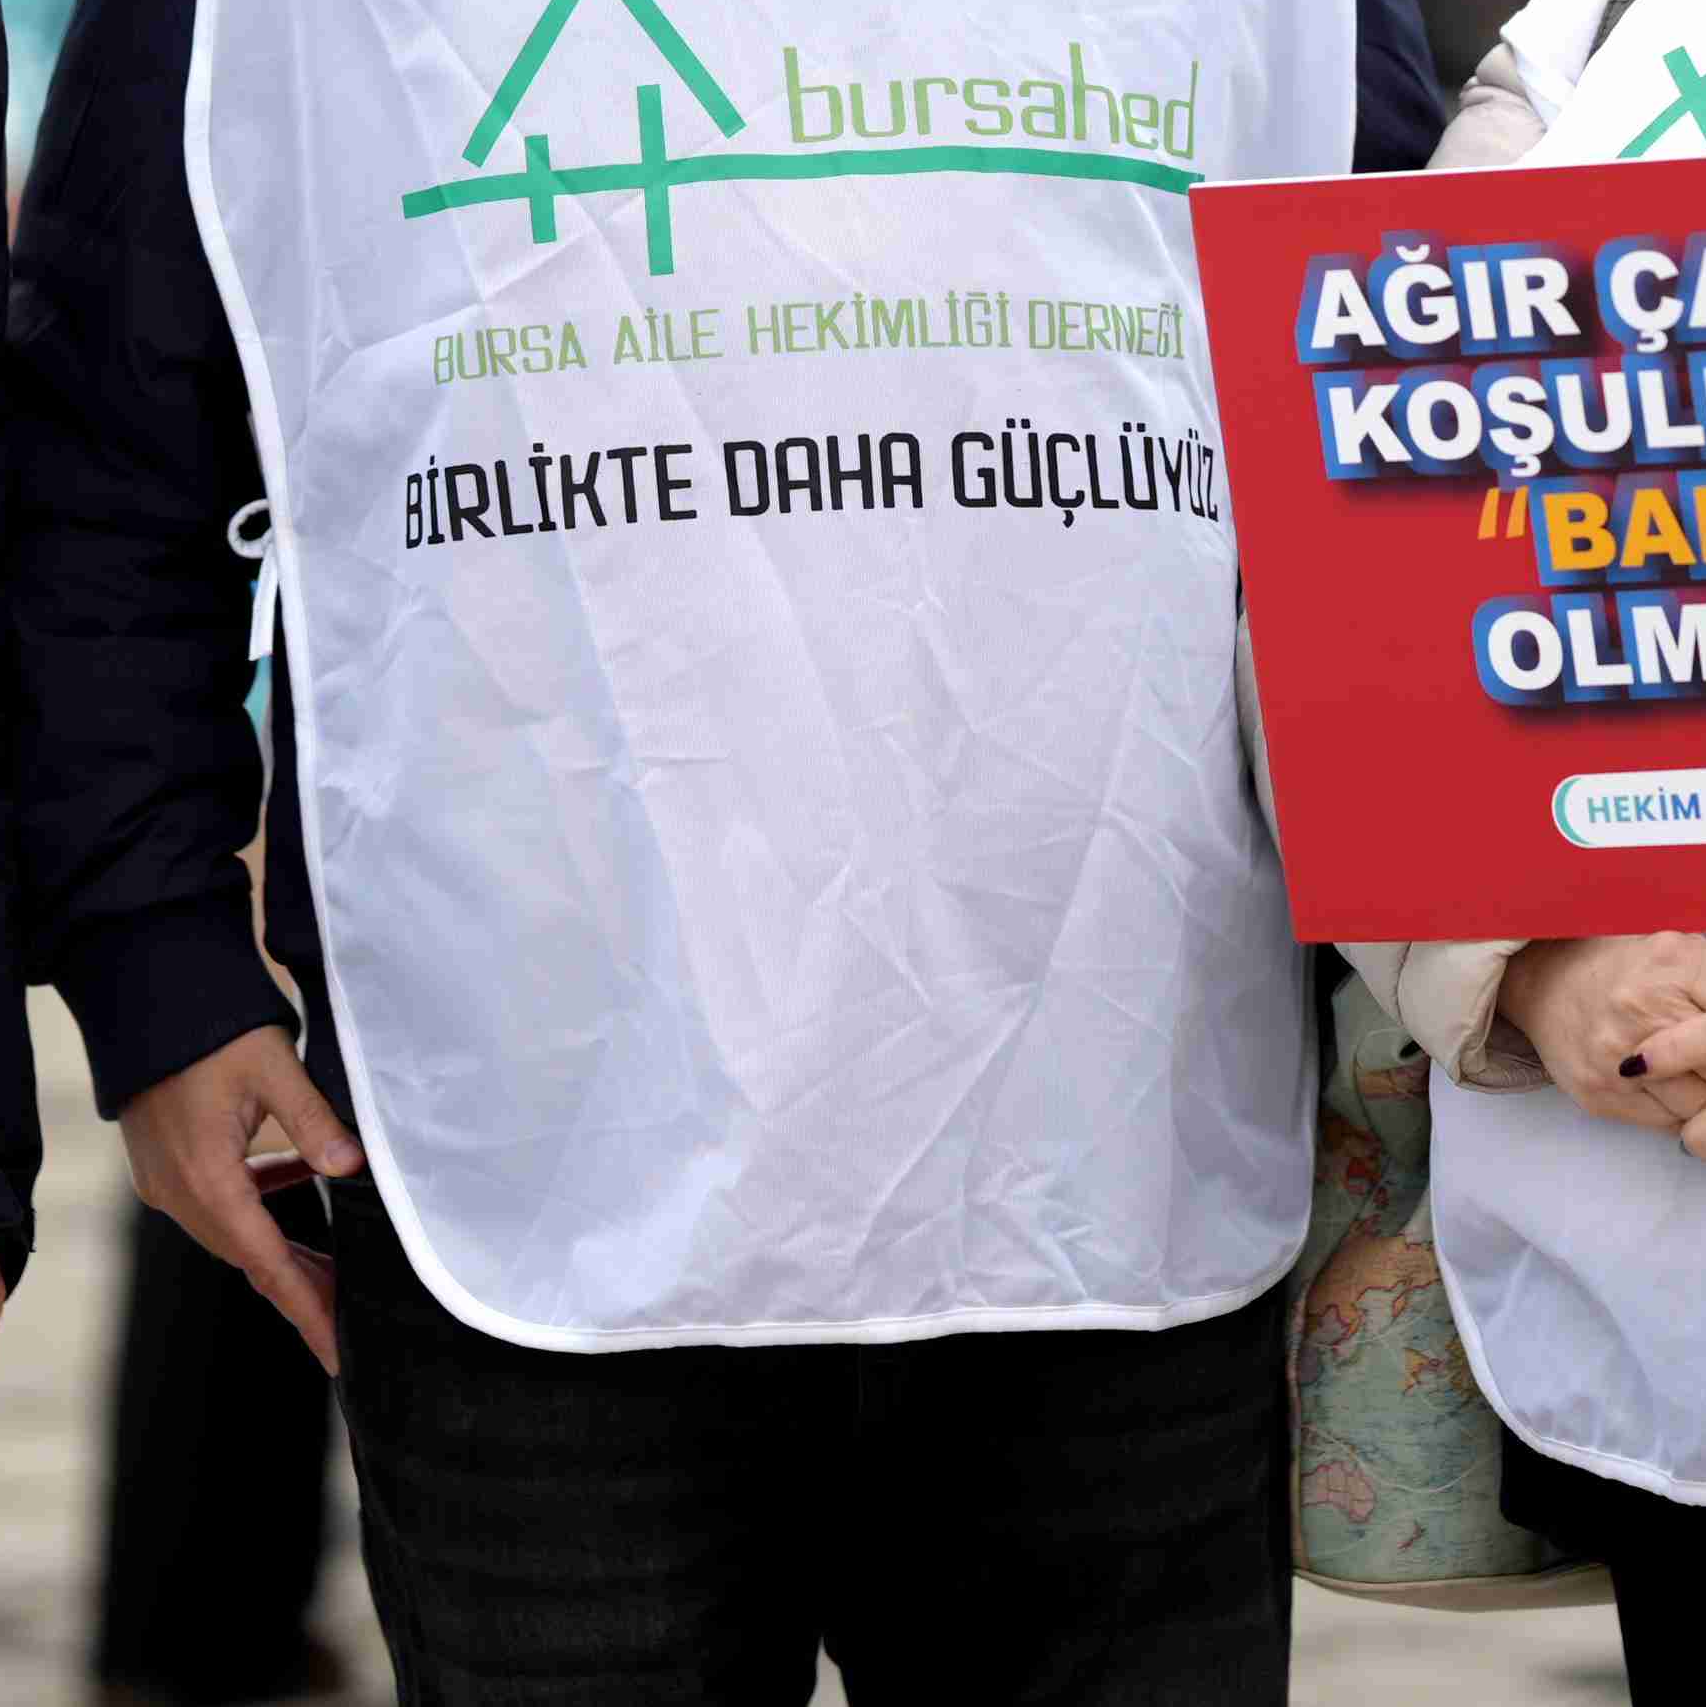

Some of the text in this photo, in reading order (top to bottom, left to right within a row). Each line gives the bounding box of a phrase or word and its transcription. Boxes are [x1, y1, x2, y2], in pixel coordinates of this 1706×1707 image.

[782, 42, 1199, 161] bursahed
[432, 289, 1185, 386] BURSA AİLE HEKİMLİĞİ DERNEĞİ
[1309, 244, 1580, 351] AĞIR
[405, 417, 1220, 551] BİRLİKTE DAHA GÜÇLÜYÜZ
[1587, 786, 1702, 823] HEKİM
